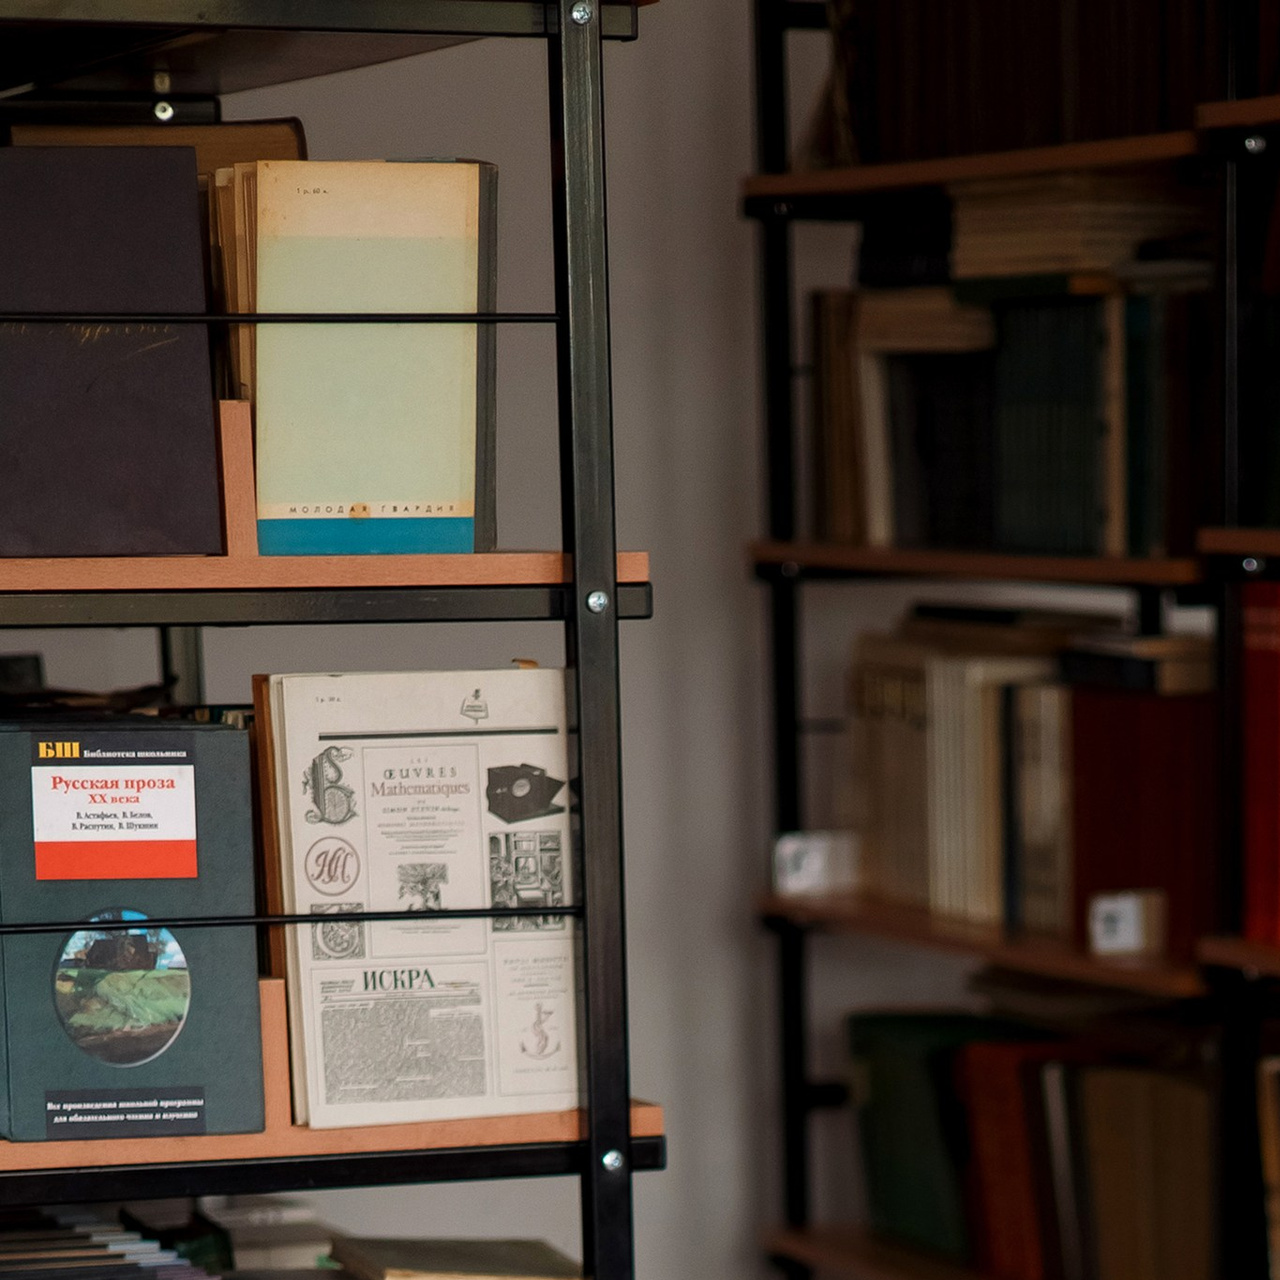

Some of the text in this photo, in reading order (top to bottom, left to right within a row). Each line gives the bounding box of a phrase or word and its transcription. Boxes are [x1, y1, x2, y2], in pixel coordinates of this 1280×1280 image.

[289, 505, 454, 514] МОЛОДАЯ ГВАРДИЯ
[38, 742, 80, 758] БШ
[83, 749, 136, 758] Библиотека
[51, 775, 176, 794] Русская проза
[371, 782, 471, 798] Mathematiques
[110, 795, 140, 804] века
[363, 968, 435, 991] ИСКРА
